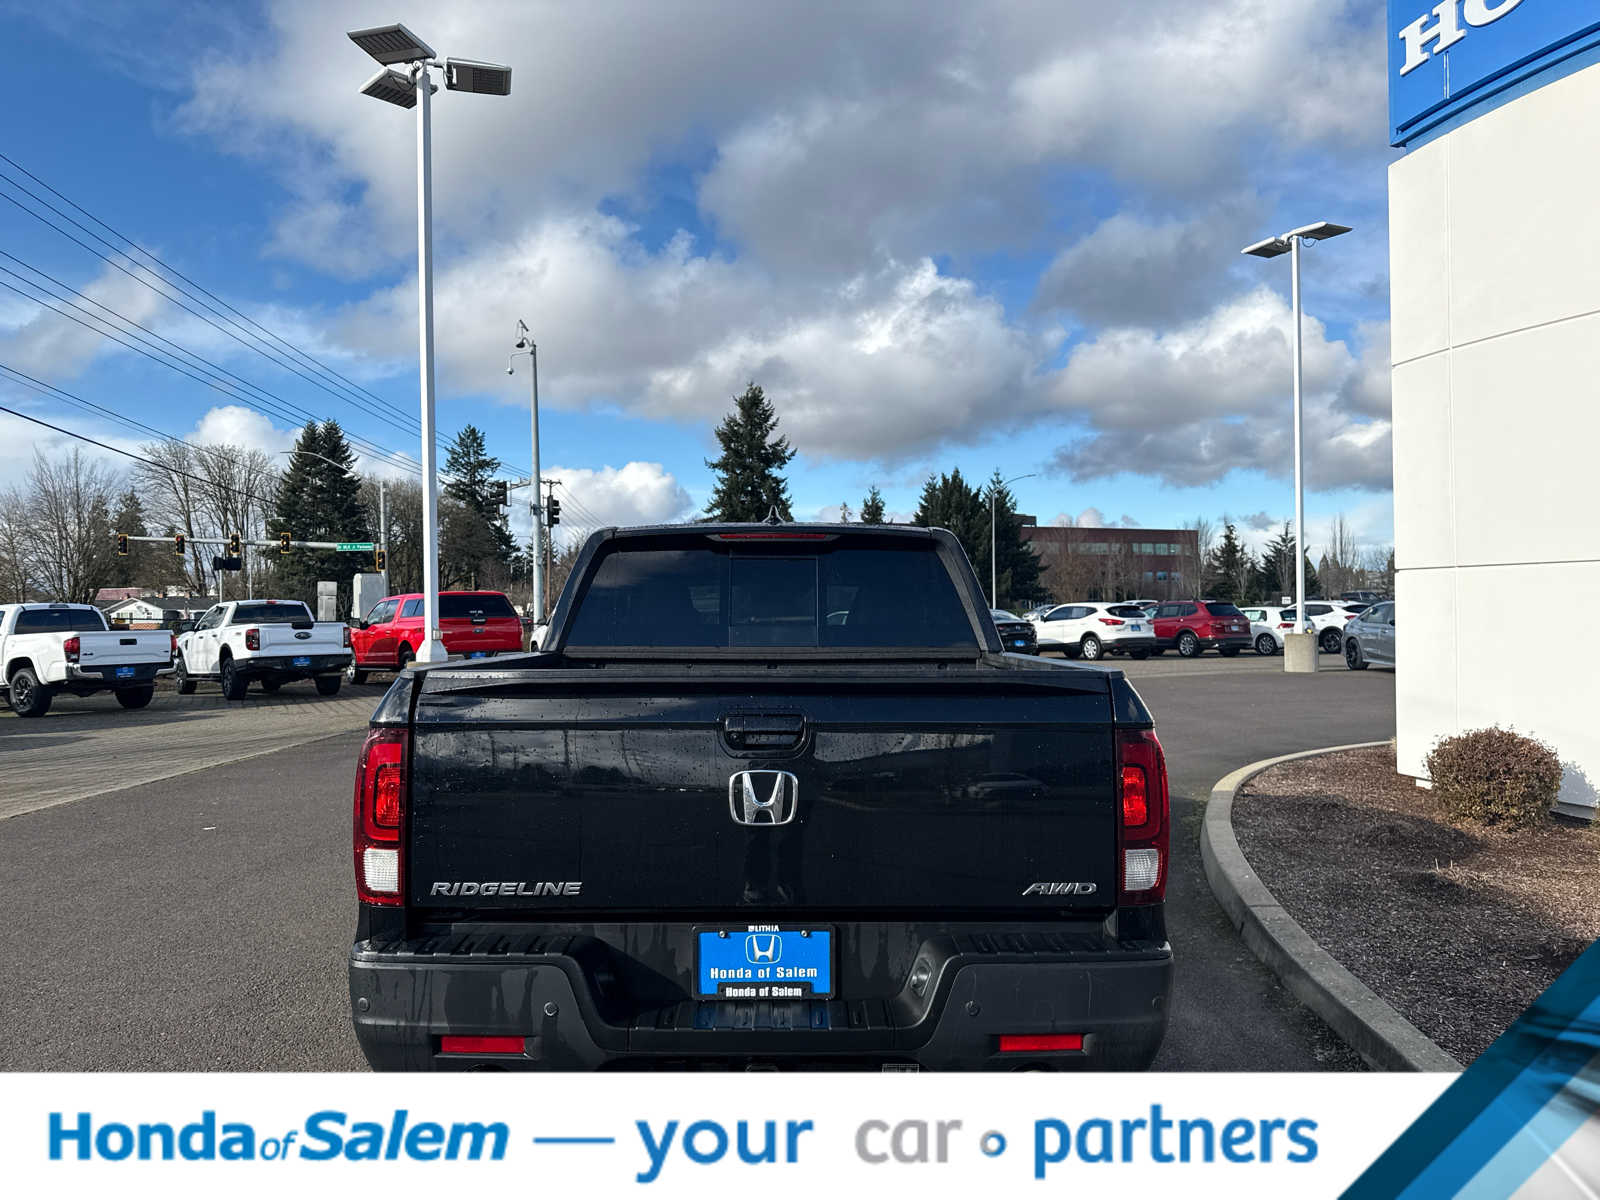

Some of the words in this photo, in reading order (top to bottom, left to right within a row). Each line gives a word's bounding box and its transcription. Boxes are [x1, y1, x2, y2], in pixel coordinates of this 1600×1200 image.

[430, 881, 583, 896] RIDGELINE
[1022, 882, 1097, 896] AWD
[710, 967, 752, 979] Honda
[758, 967, 770, 978] of
[776, 966, 818, 978] Salem
[725, 987, 756, 997] Honda
[758, 987, 770, 997] of
[772, 987, 802, 997] Salem
